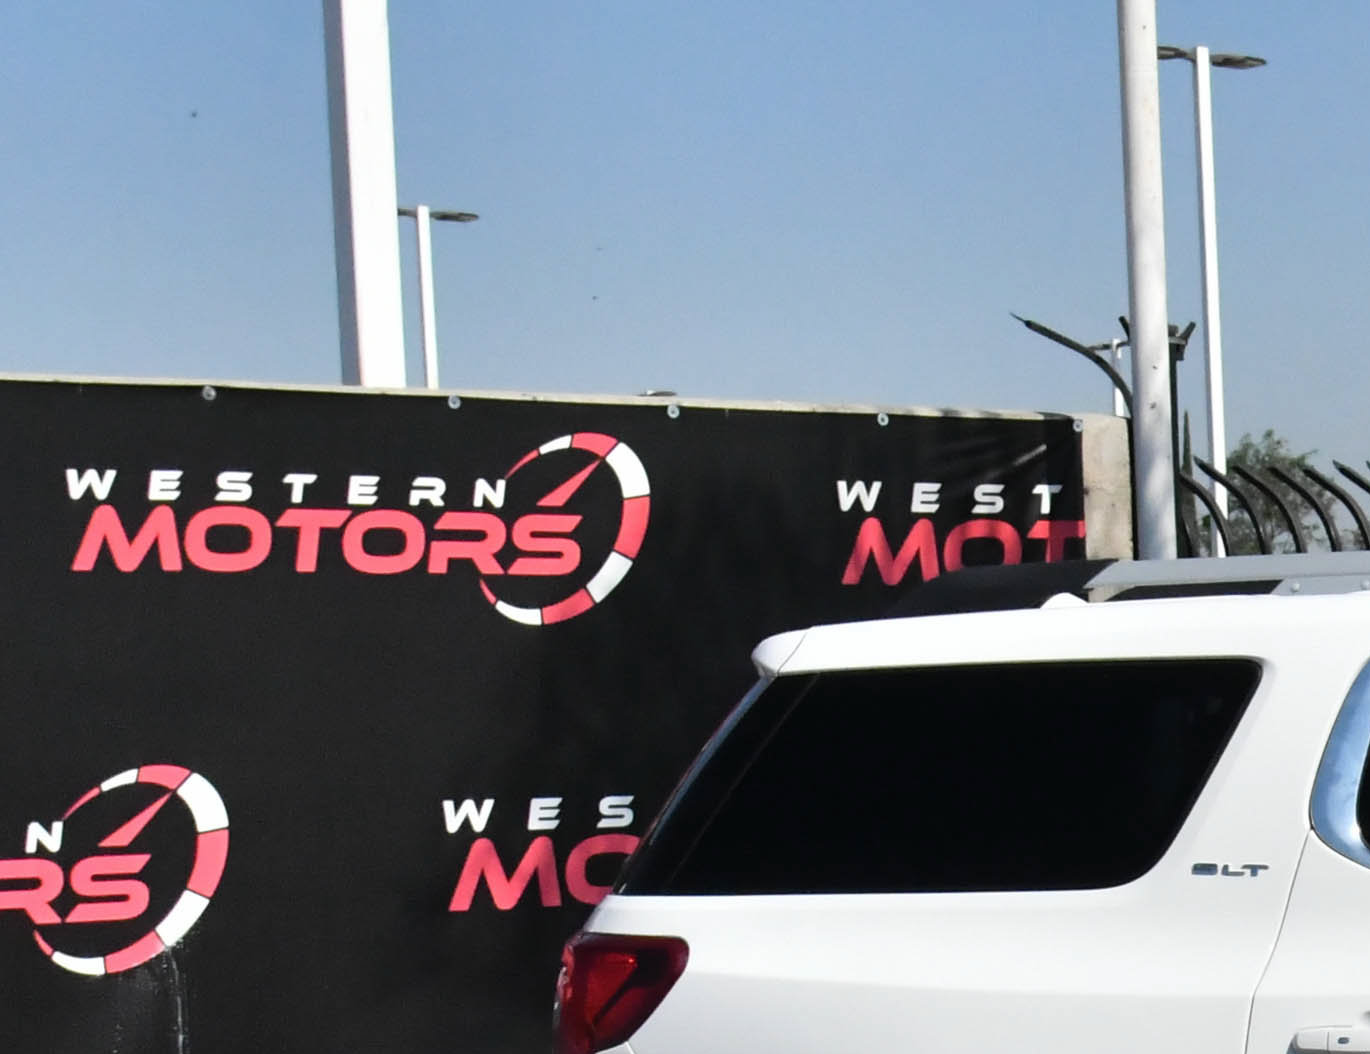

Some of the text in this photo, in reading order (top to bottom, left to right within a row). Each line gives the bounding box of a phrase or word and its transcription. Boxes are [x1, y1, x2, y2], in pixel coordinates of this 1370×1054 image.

[65, 468, 507, 508] WESTERN
[836, 480, 1063, 515] WEST
[70, 505, 583, 576] MOTORS
[442, 795, 635, 834] WES
